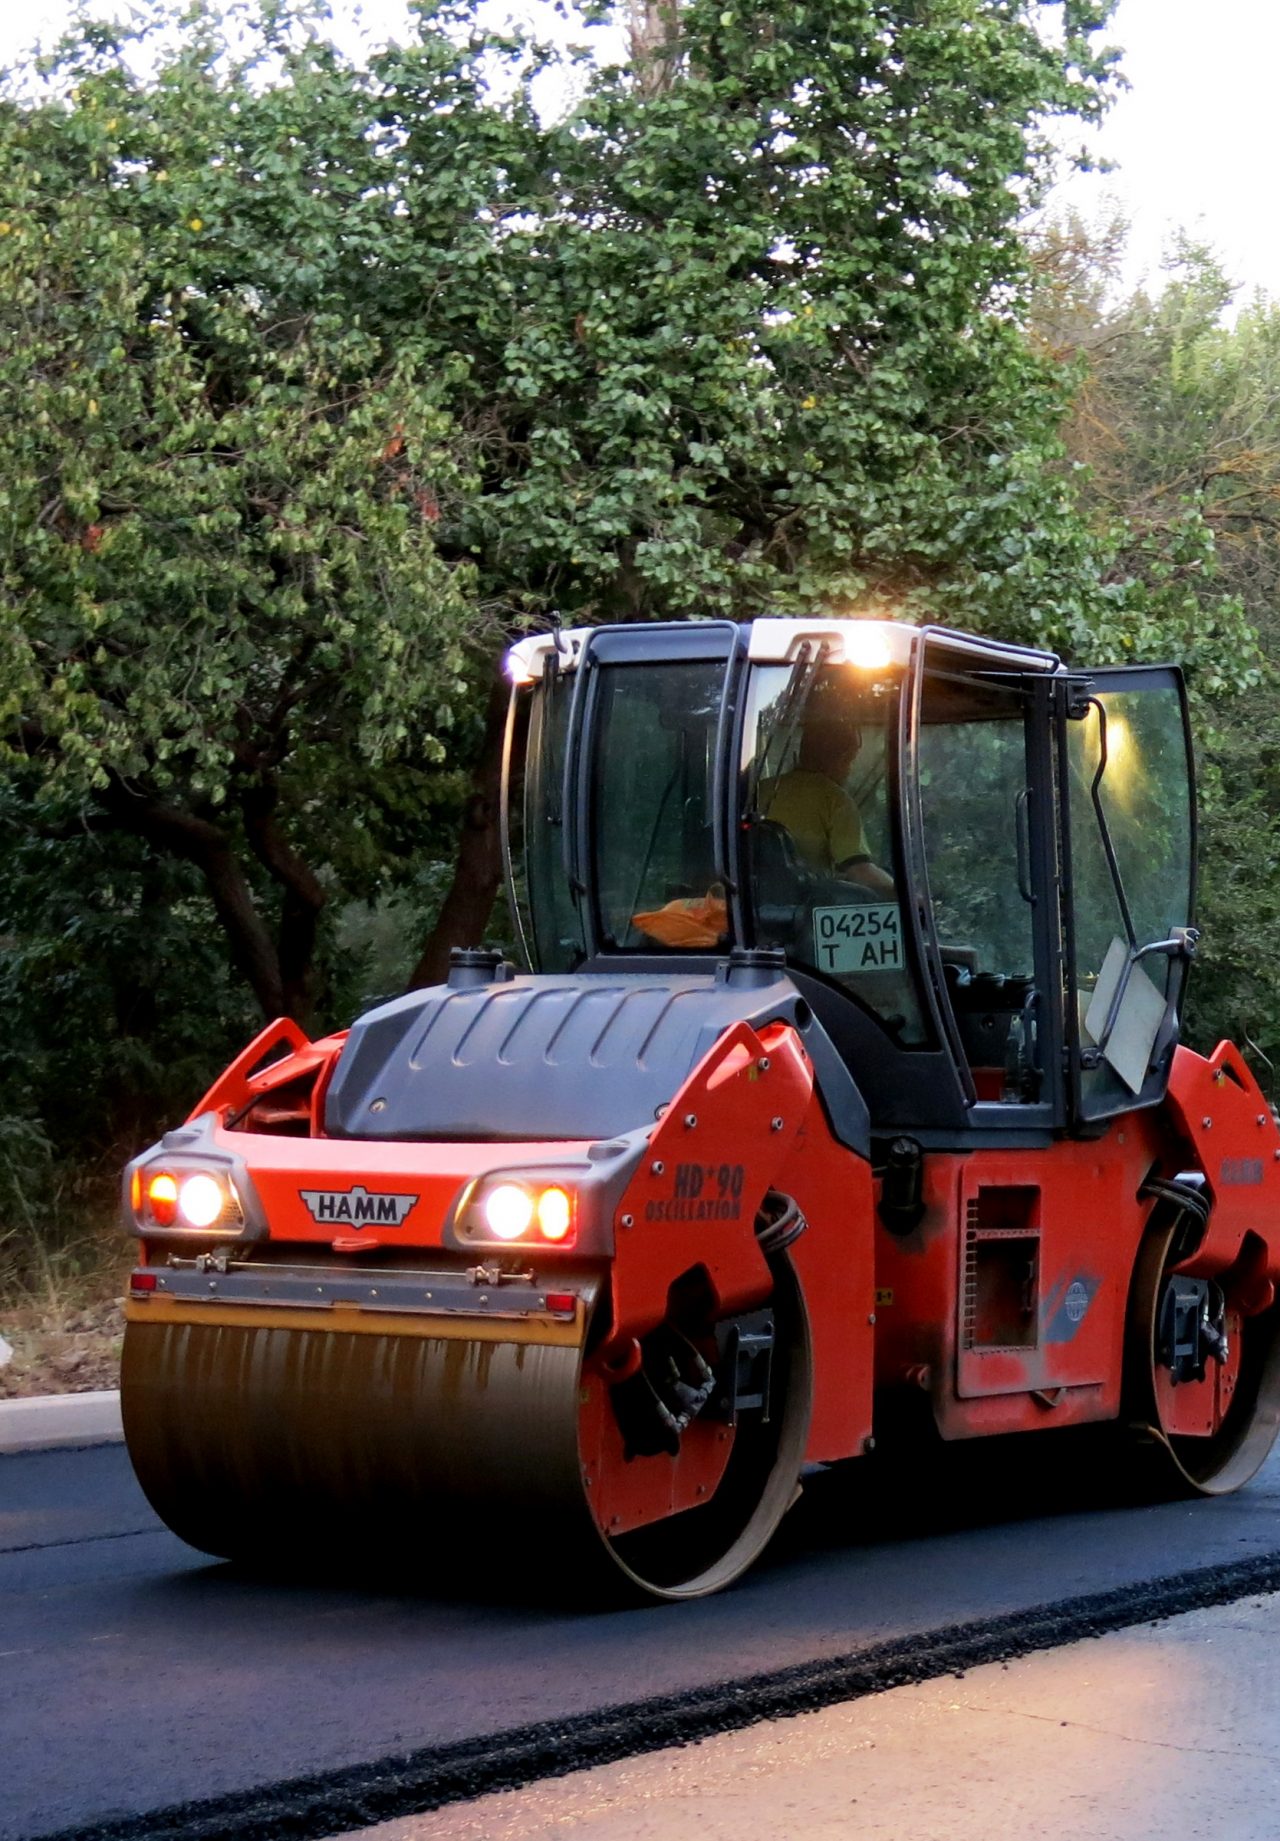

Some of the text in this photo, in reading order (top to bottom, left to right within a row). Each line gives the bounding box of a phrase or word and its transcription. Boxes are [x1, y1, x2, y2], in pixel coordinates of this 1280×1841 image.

[820, 910, 898, 938] 04254
[822, 940, 899, 968] T AH
[318, 1195, 397, 1221] HAMM
[645, 1199, 741, 1221] OSCILLATION
